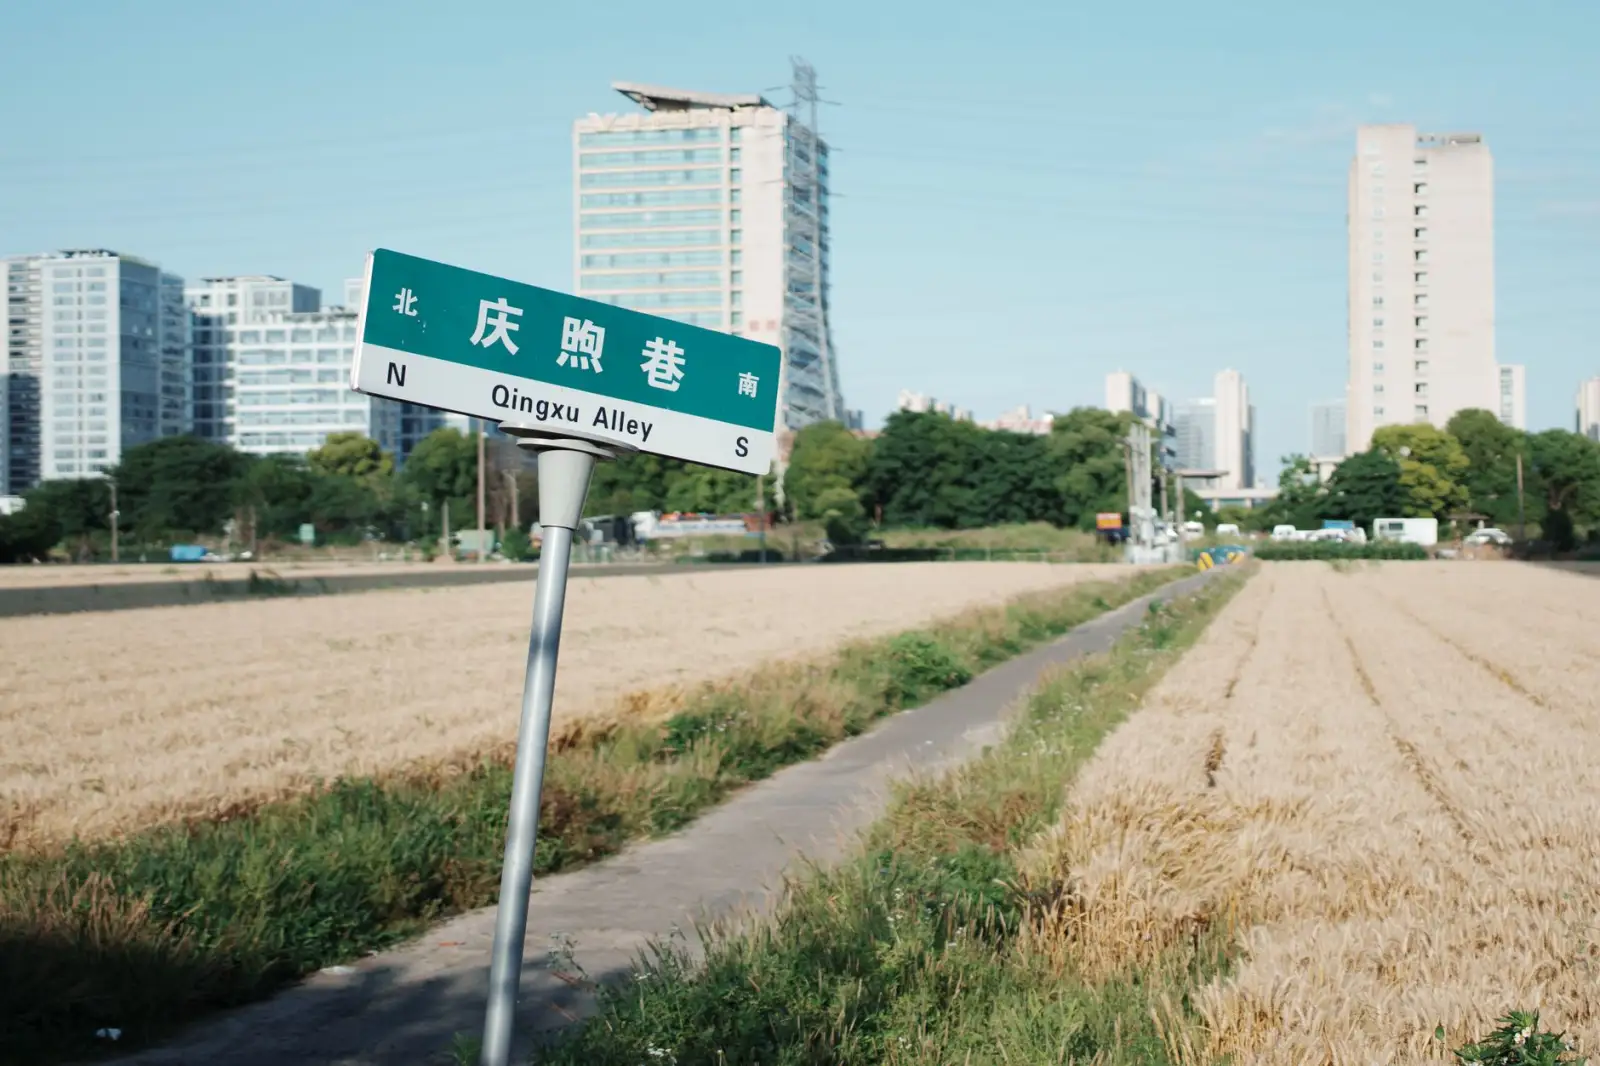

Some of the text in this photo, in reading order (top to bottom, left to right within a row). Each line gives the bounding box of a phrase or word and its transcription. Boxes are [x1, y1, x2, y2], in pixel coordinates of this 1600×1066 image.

[392, 287, 418, 316] 北
[469, 298, 686, 392] 庆煦巷
[386, 362, 406, 387] N
[738, 371, 759, 398] 南
[491, 384, 653, 442] Qingxu Alley
[735, 436, 749, 458] S
